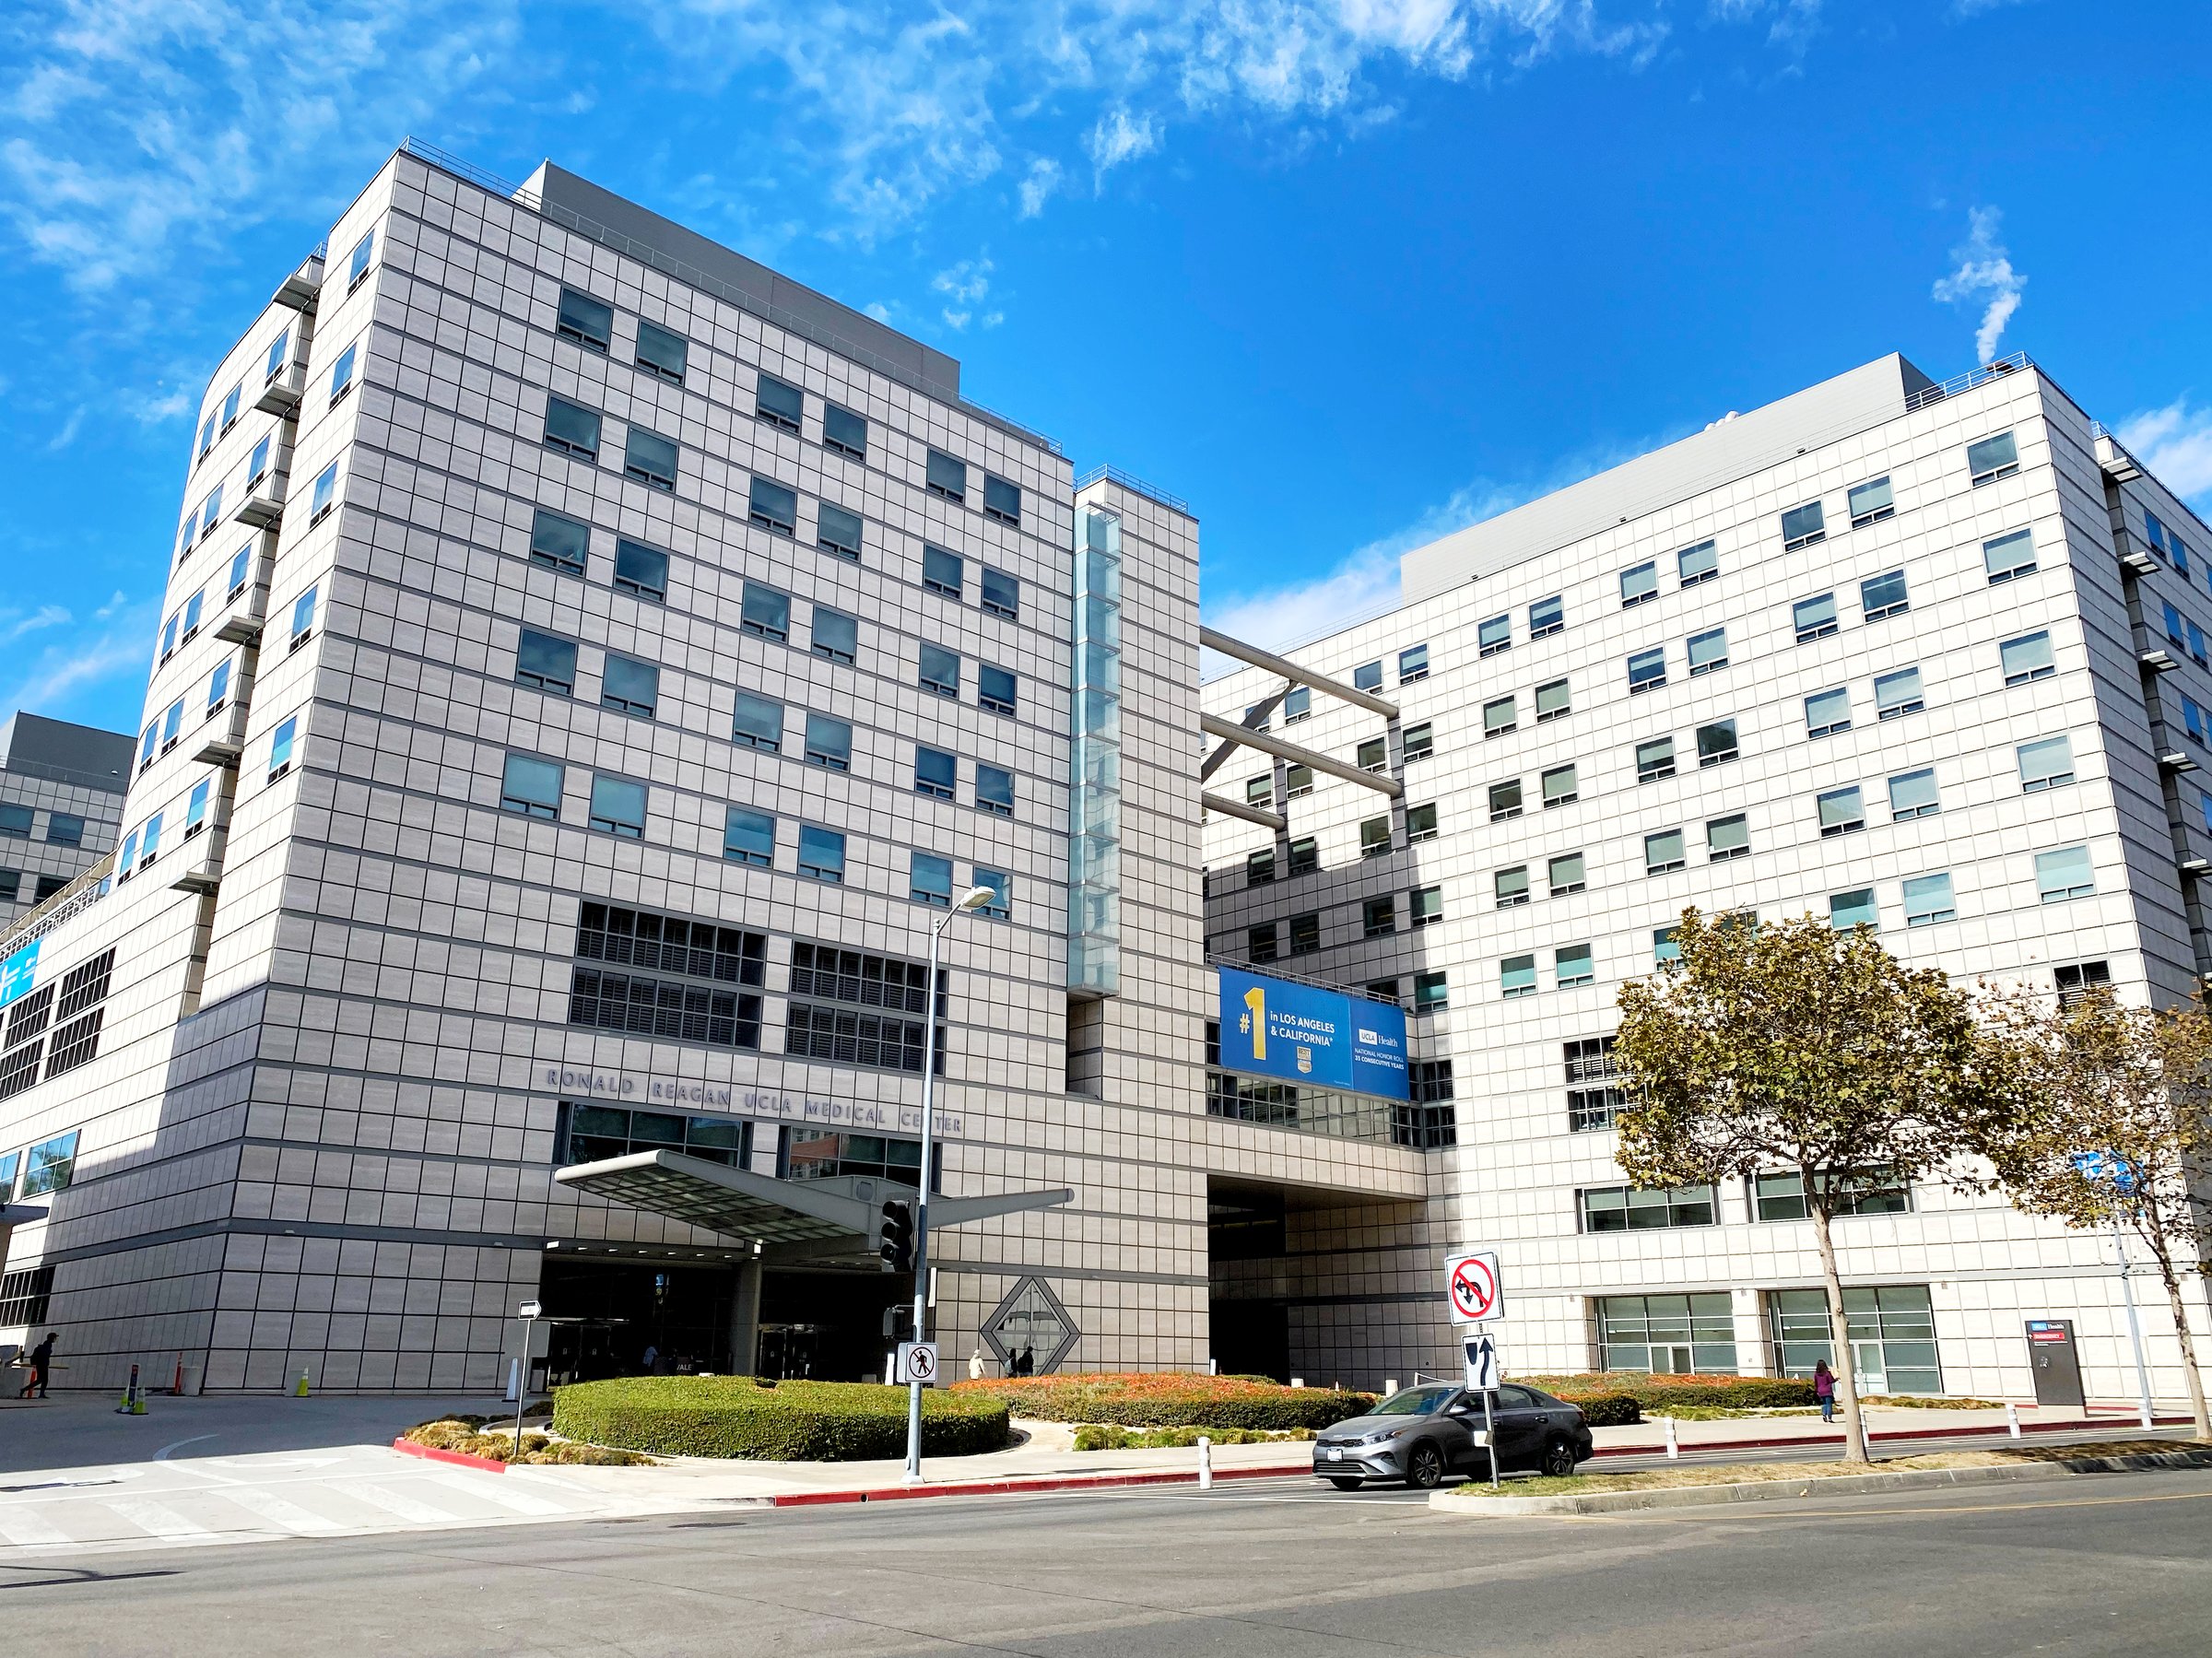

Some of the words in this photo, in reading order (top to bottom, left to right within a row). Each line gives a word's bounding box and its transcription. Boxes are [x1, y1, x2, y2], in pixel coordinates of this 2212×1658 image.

[1239, 986, 1266, 1061] #1
[1270, 1010, 1278, 1022] in
[1279, 1013, 1296, 1026] LOS
[1298, 1017, 1335, 1033] ANGELES
[1270, 1025, 1278, 1037] &
[1378, 1035, 1398, 1047] Health
[1355, 1048, 1376, 1057] NATIONAL
[1377, 1052, 1393, 1060] HONOR
[1361, 1056, 1390, 1067] CONSECUTIVE
[547, 1069, 634, 1094] RONALD
[653, 1081, 730, 1104] REAGAN
[744, 1092, 792, 1113] UCLA
[805, 1099, 886, 1124] MEDICAL
[901, 1112, 961, 1132] CETER
